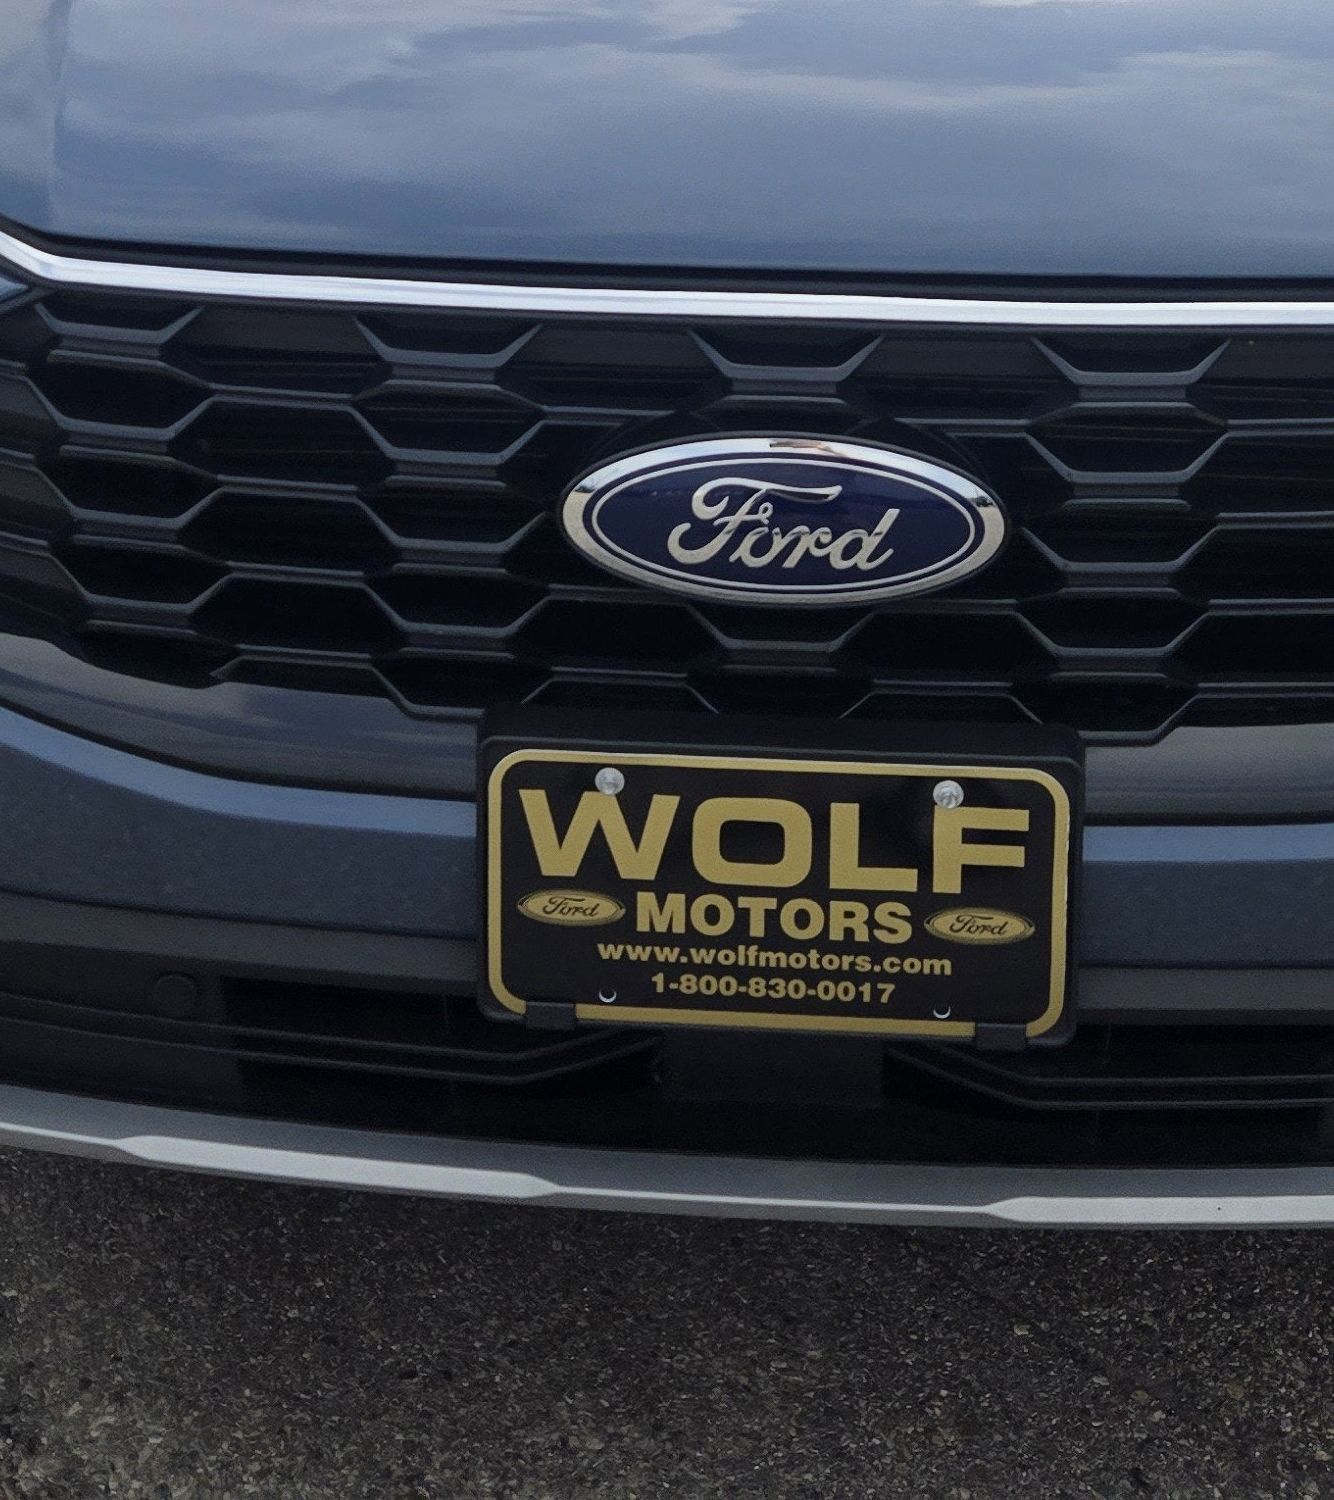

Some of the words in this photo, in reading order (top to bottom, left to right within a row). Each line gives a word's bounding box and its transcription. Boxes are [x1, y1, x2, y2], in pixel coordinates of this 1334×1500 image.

[667, 476, 900, 571] Ford
[519, 788, 1030, 894] WOLF
[543, 896, 600, 917] Ford
[636, 891, 913, 944] MOTORS
[949, 914, 1009, 935] Ford
[598, 943, 952, 976] www.wolfmotors.com
[652, 972, 896, 1004] 1-800-830-0017
